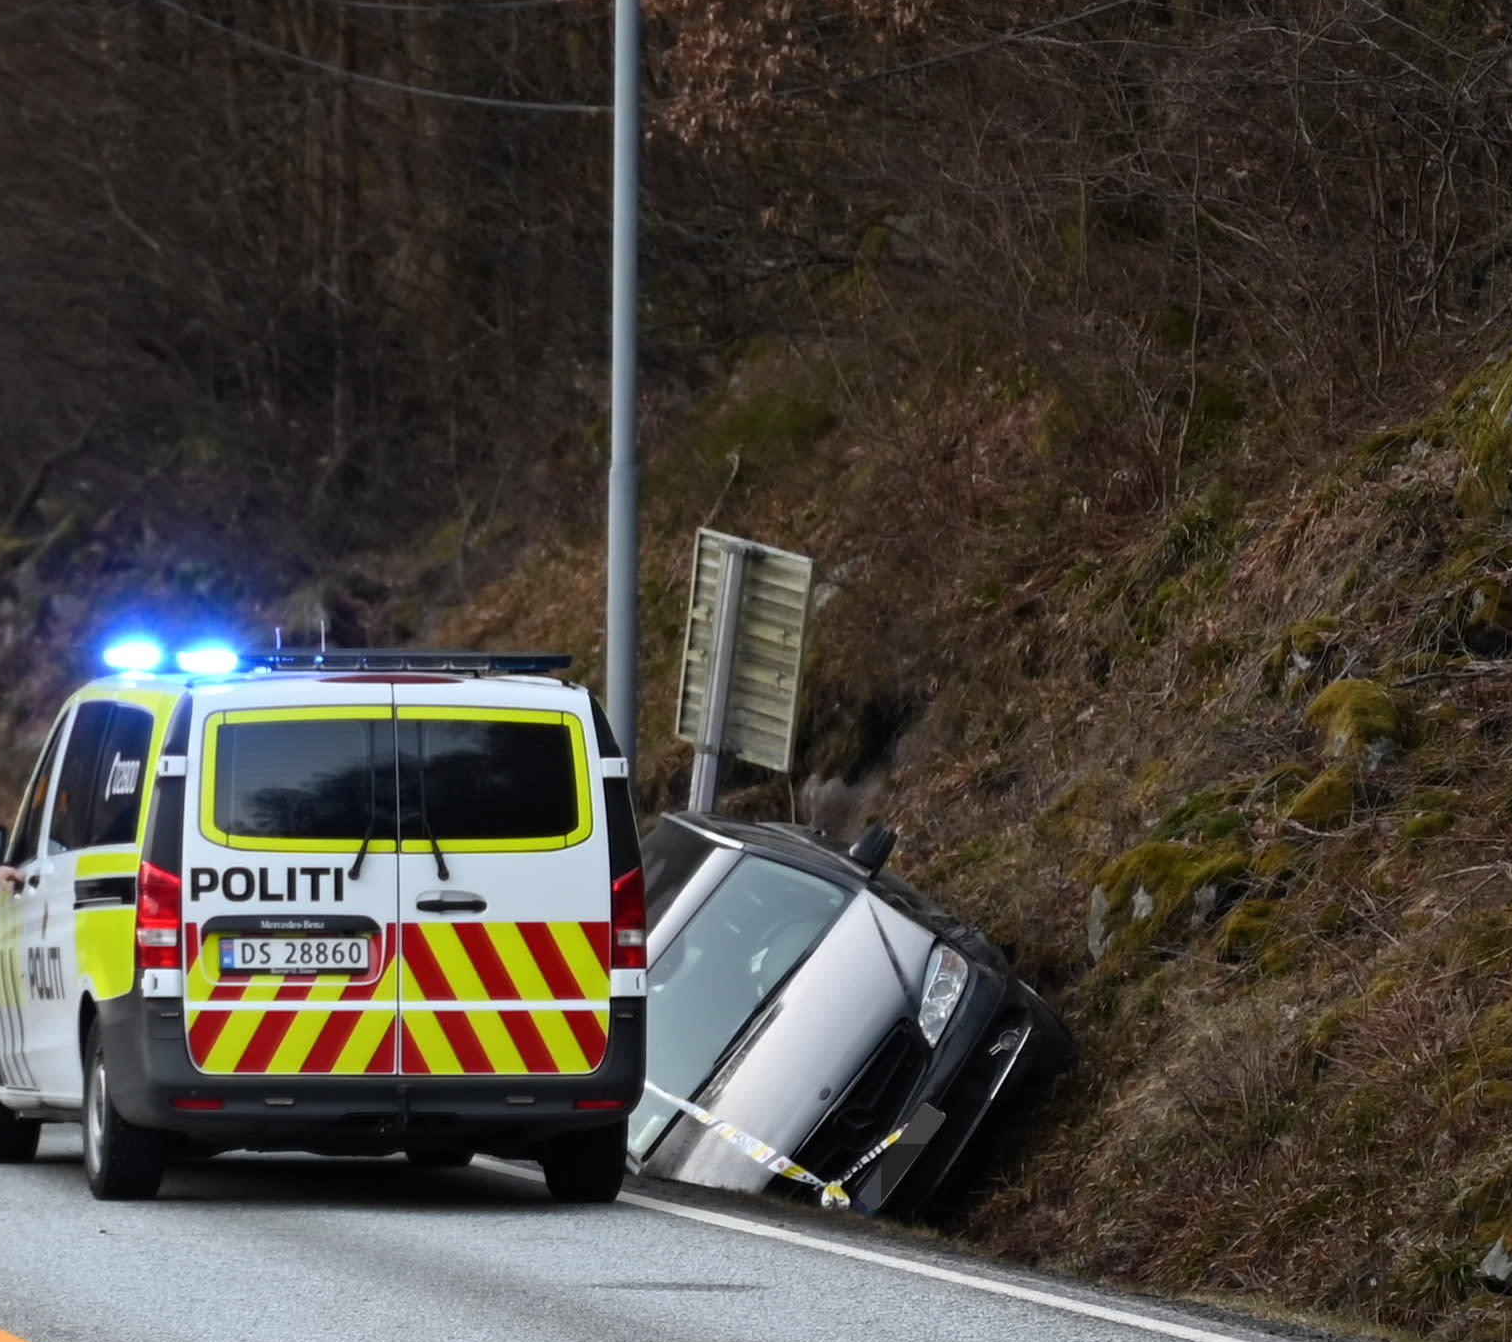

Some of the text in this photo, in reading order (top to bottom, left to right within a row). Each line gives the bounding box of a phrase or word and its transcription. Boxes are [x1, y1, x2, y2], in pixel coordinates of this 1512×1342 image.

[190, 866, 344, 902] POLITI
[260, 920, 325, 930] Mercedes-Benz
[241, 942, 363, 965] DS 28860
[27, 946, 66, 1001] POLITI
